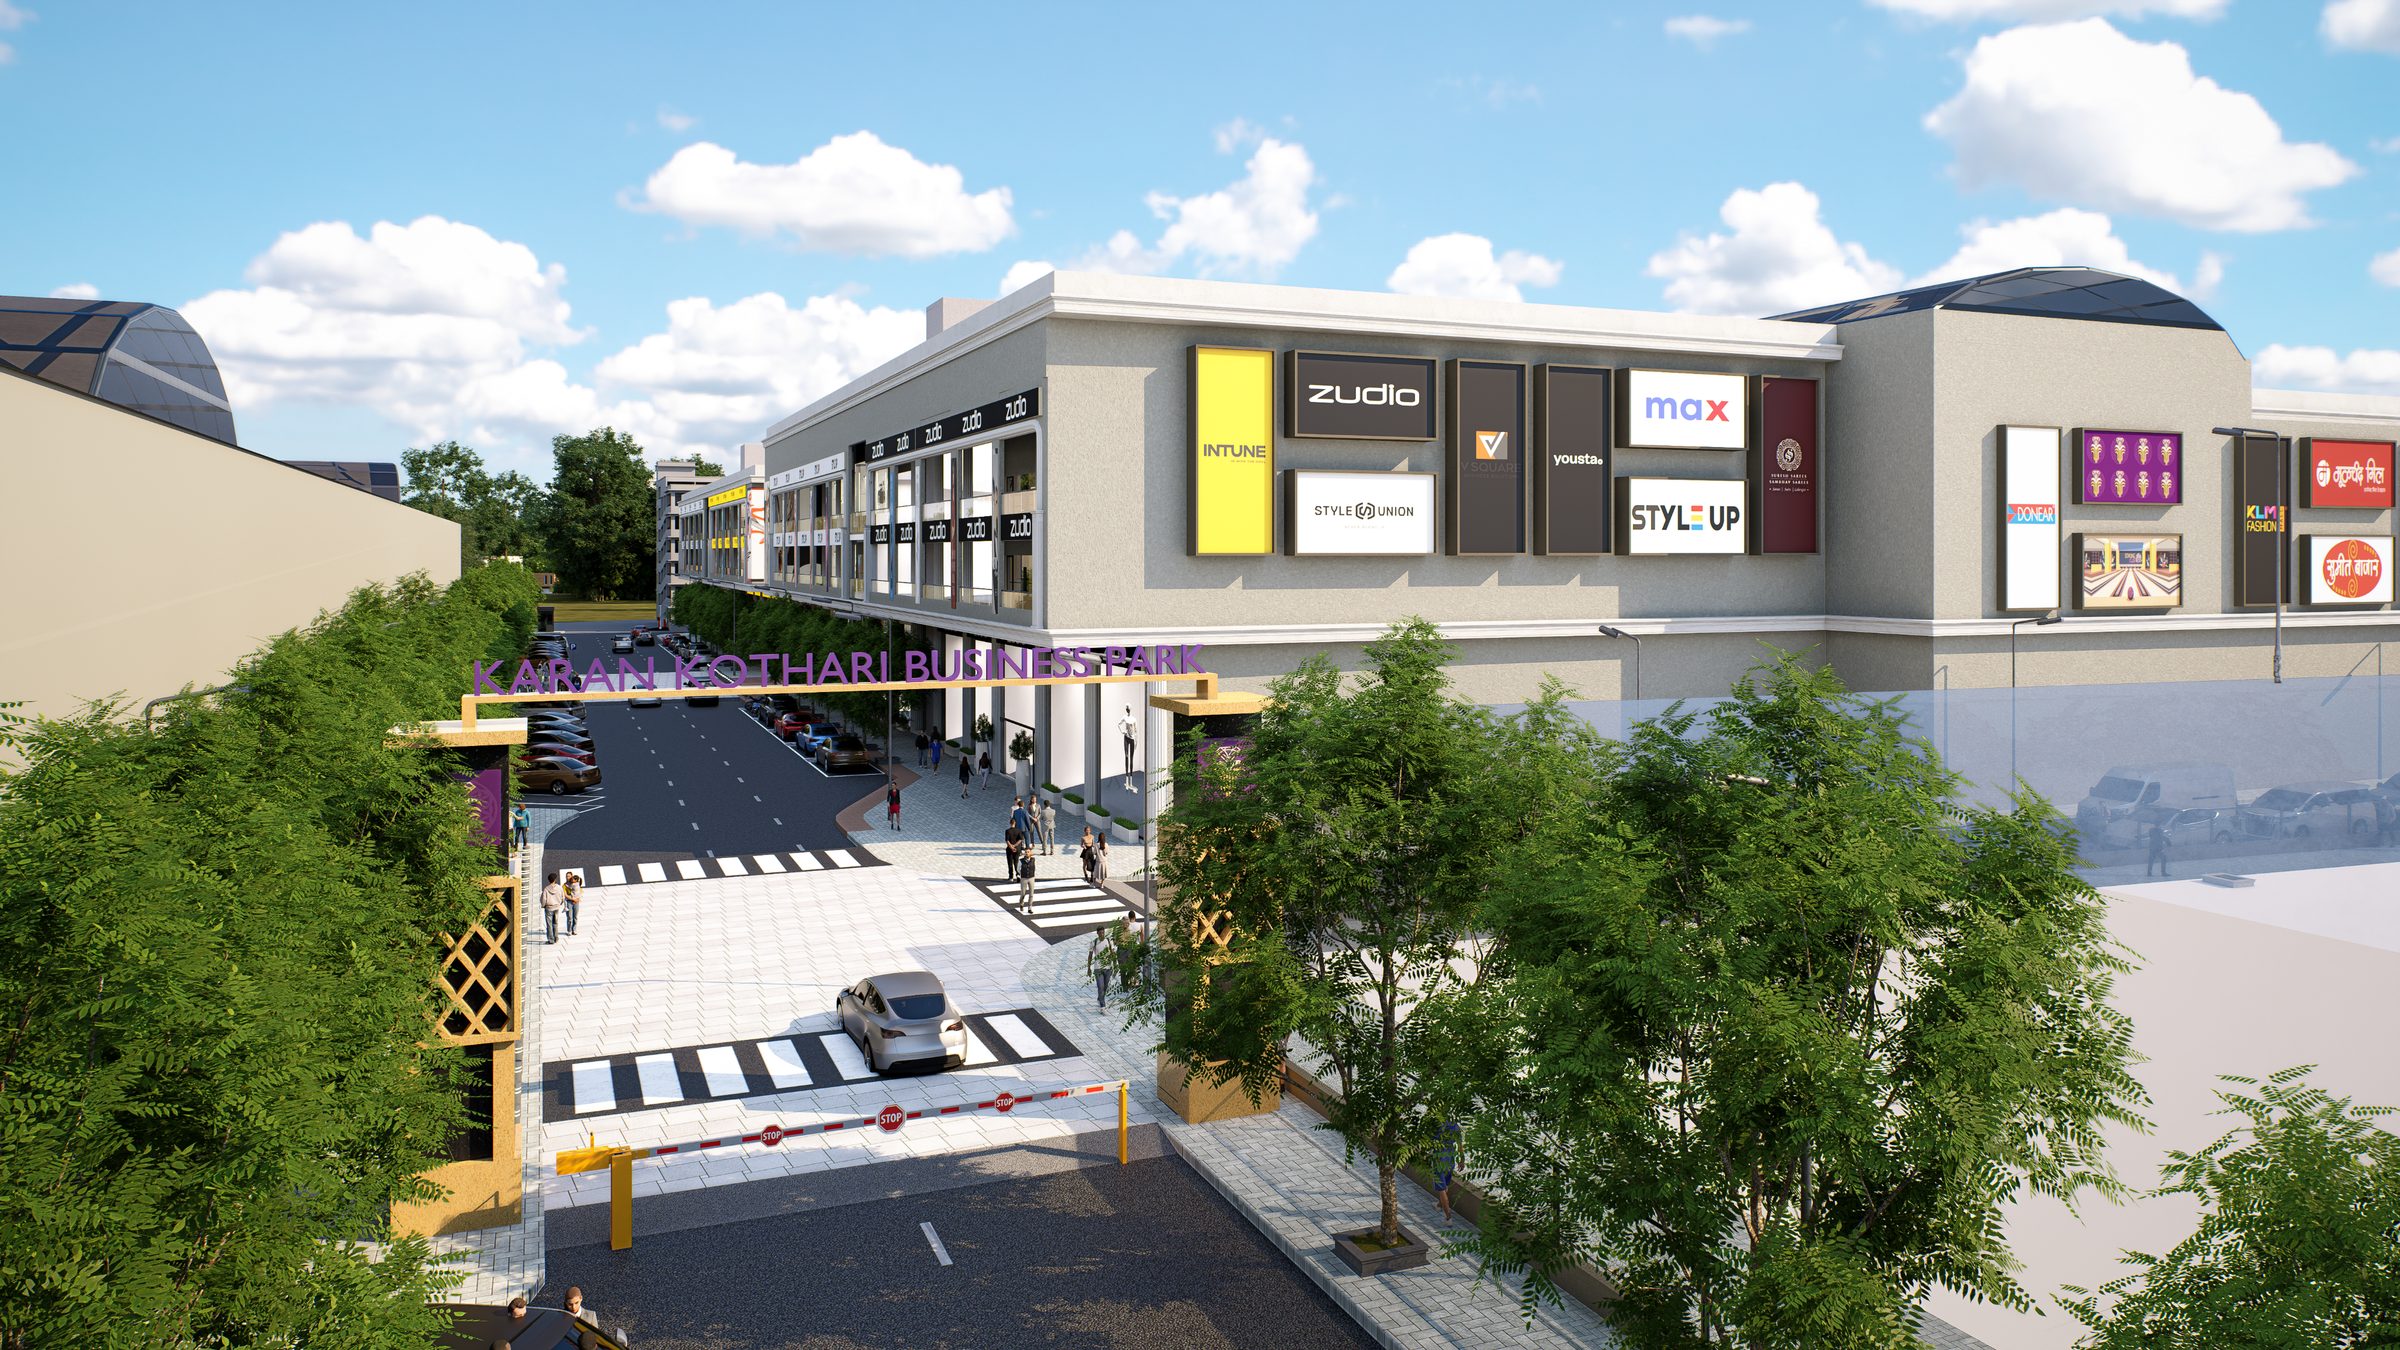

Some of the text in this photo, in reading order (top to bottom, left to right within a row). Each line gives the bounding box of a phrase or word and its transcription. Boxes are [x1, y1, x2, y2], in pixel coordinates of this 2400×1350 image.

[1308, 383, 1420, 407] zudio
[1646, 397, 1729, 422] max
[1204, 444, 1266, 458] INTUNE
[1314, 506, 1414, 516] STYLE UNION
[1632, 505, 1740, 531] STYLE UP
[2017, 506, 2054, 522] DONEAR
[2246, 505, 2277, 519] KLM
[2246, 520, 2277, 532] FASHION
[474, 644, 1205, 696] KARAN KOTHARI BUSINESS PARK
[996, 1097, 1013, 1108] STOP
[880, 1112, 902, 1125] STOP
[763, 1130, 782, 1141] STOP
